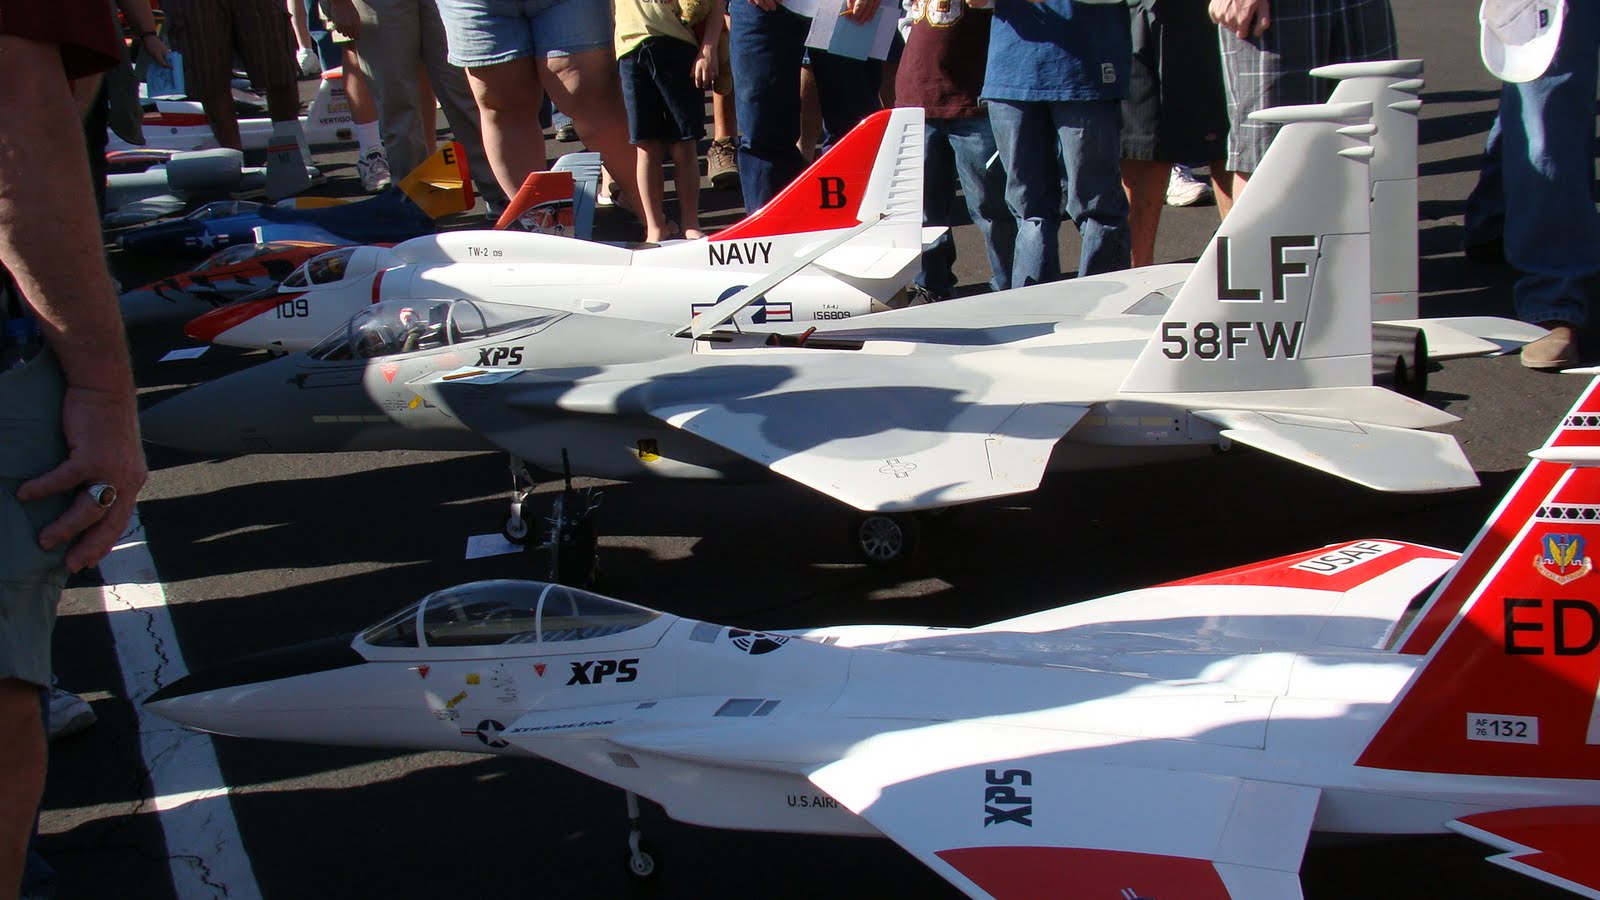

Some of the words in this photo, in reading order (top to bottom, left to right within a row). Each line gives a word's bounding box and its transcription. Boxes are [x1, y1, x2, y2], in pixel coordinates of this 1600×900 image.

[319, 115, 351, 125] VERTIGO
[442, 147, 456, 166] E
[818, 176, 848, 209] B
[468, 246, 489, 257] TW-2
[708, 241, 773, 266] NAVY
[1216, 235, 1318, 303] LF
[276, 298, 309, 319] 109
[1161, 321, 1304, 361] 58FW
[474, 346, 524, 367] XPS
[1299, 542, 1383, 572] USAF
[1503, 597, 1600, 657] ED
[566, 658, 640, 686] XPS
[1475, 718, 1488, 727] AF
[1475, 727, 1488, 737] 76
[1489, 720, 1528, 738] 132
[984, 768, 1033, 829] XPS
